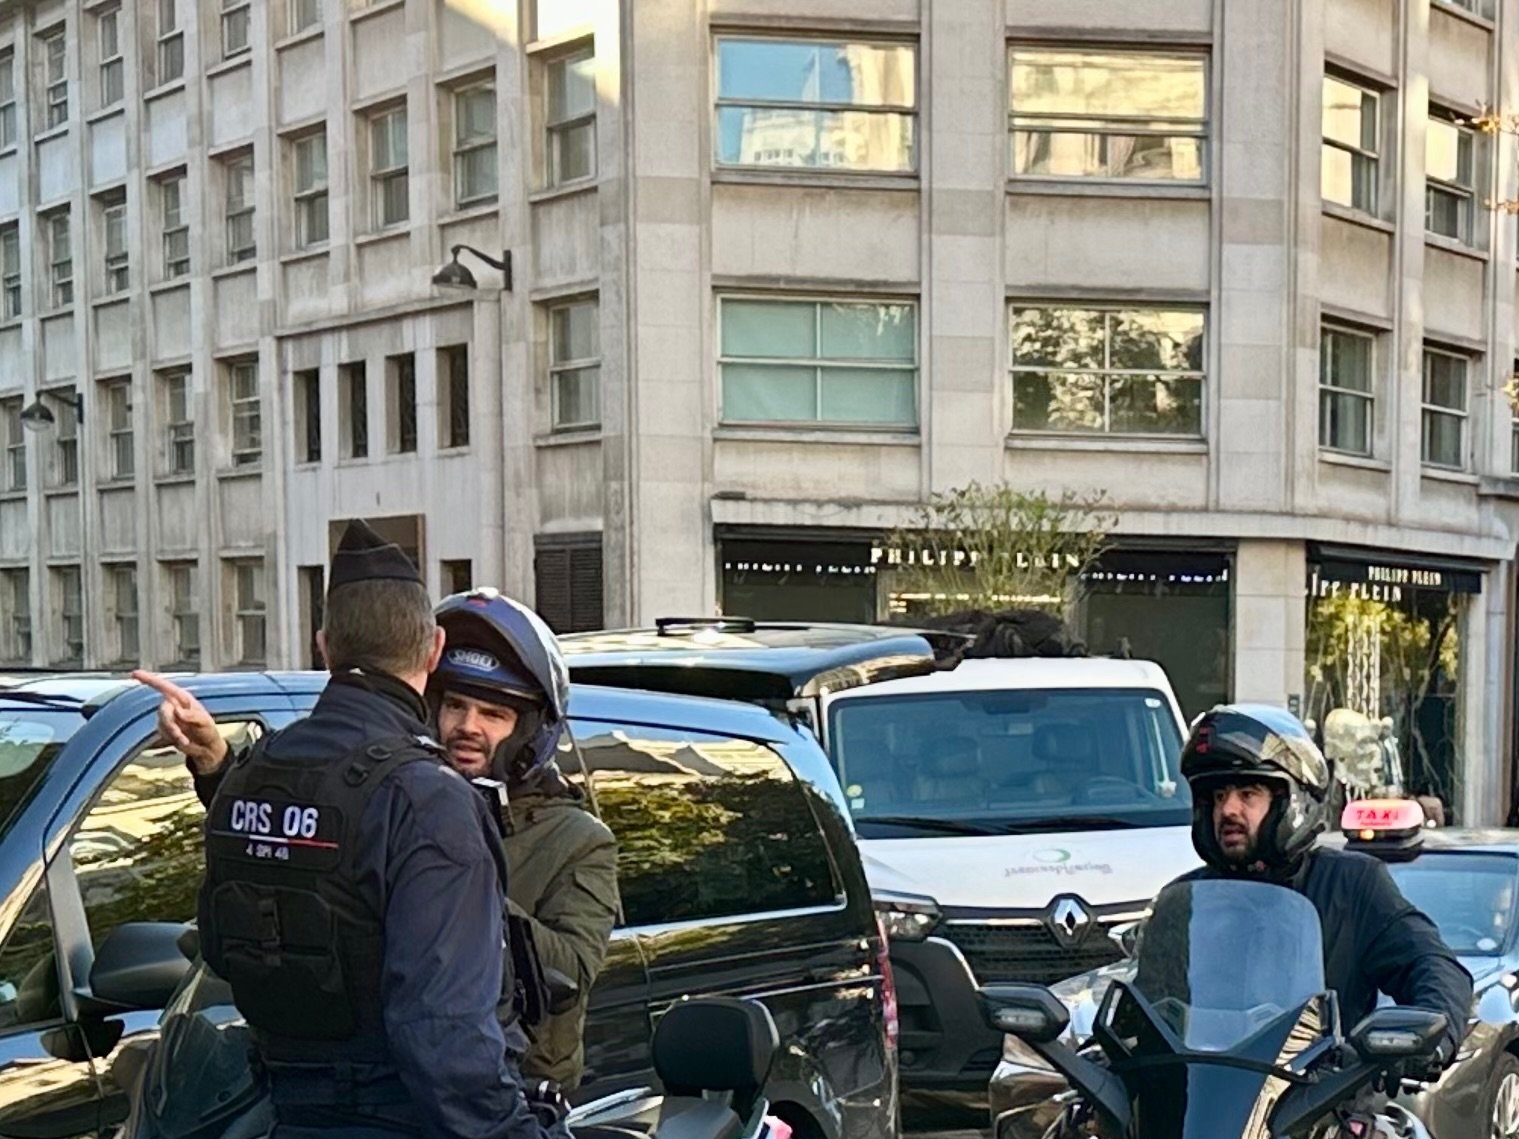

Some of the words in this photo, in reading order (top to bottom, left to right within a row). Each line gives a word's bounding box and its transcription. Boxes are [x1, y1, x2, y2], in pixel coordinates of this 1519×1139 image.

[231, 800, 272, 834] CRS
[283, 805, 319, 838] 06
[1356, 809, 1399, 820] TAXI
